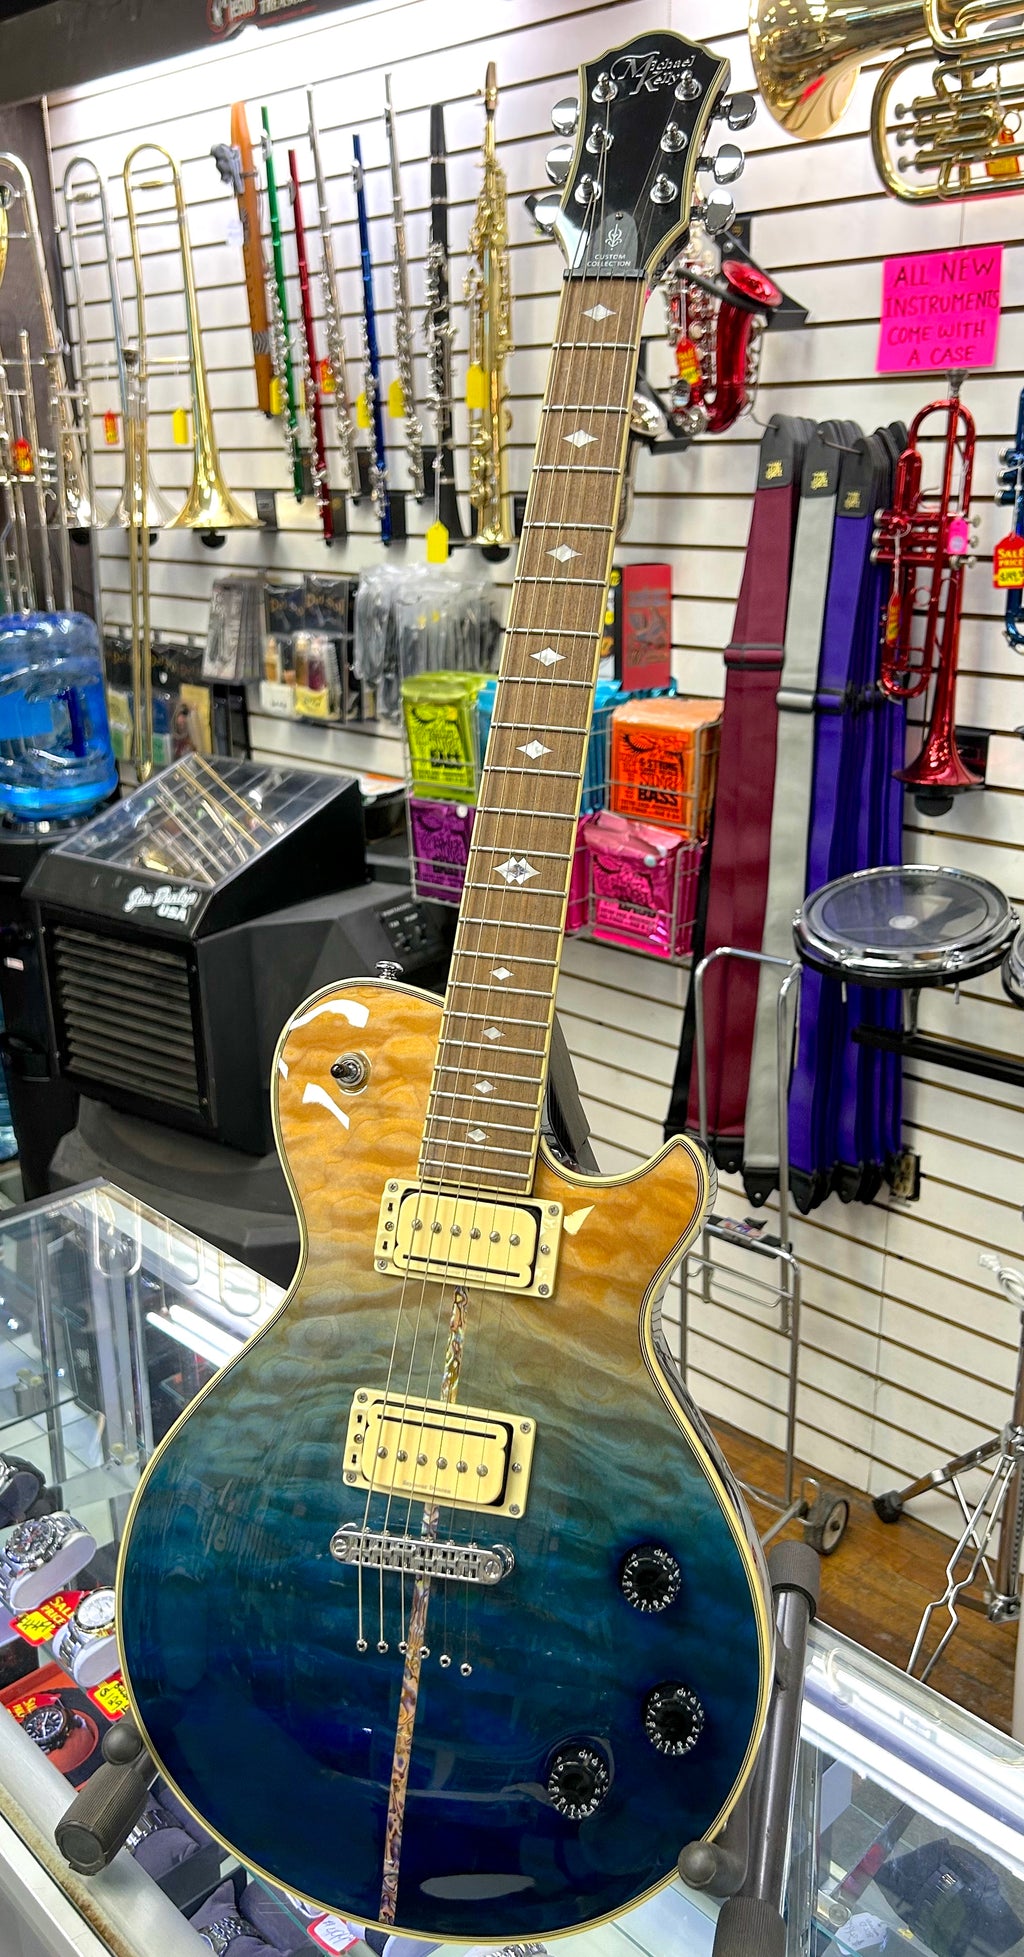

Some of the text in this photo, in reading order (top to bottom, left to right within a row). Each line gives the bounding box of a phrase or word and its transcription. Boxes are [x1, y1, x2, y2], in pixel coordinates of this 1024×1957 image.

[611, 51, 696, 80] Michael
[629, 70, 680, 95] Kelly
[893, 256, 995, 288] ALL NEW
[884, 289, 1000, 318] INSTRUMENTS
[886, 319, 986, 346] COME WITH
[906, 345, 977, 367] A CASE
[638, 784, 679, 807] BASS
[124, 885, 199, 913] Jim Dunlop
[157, 903, 188, 922] USA
[40, 1605, 68, 1627] PRICE
